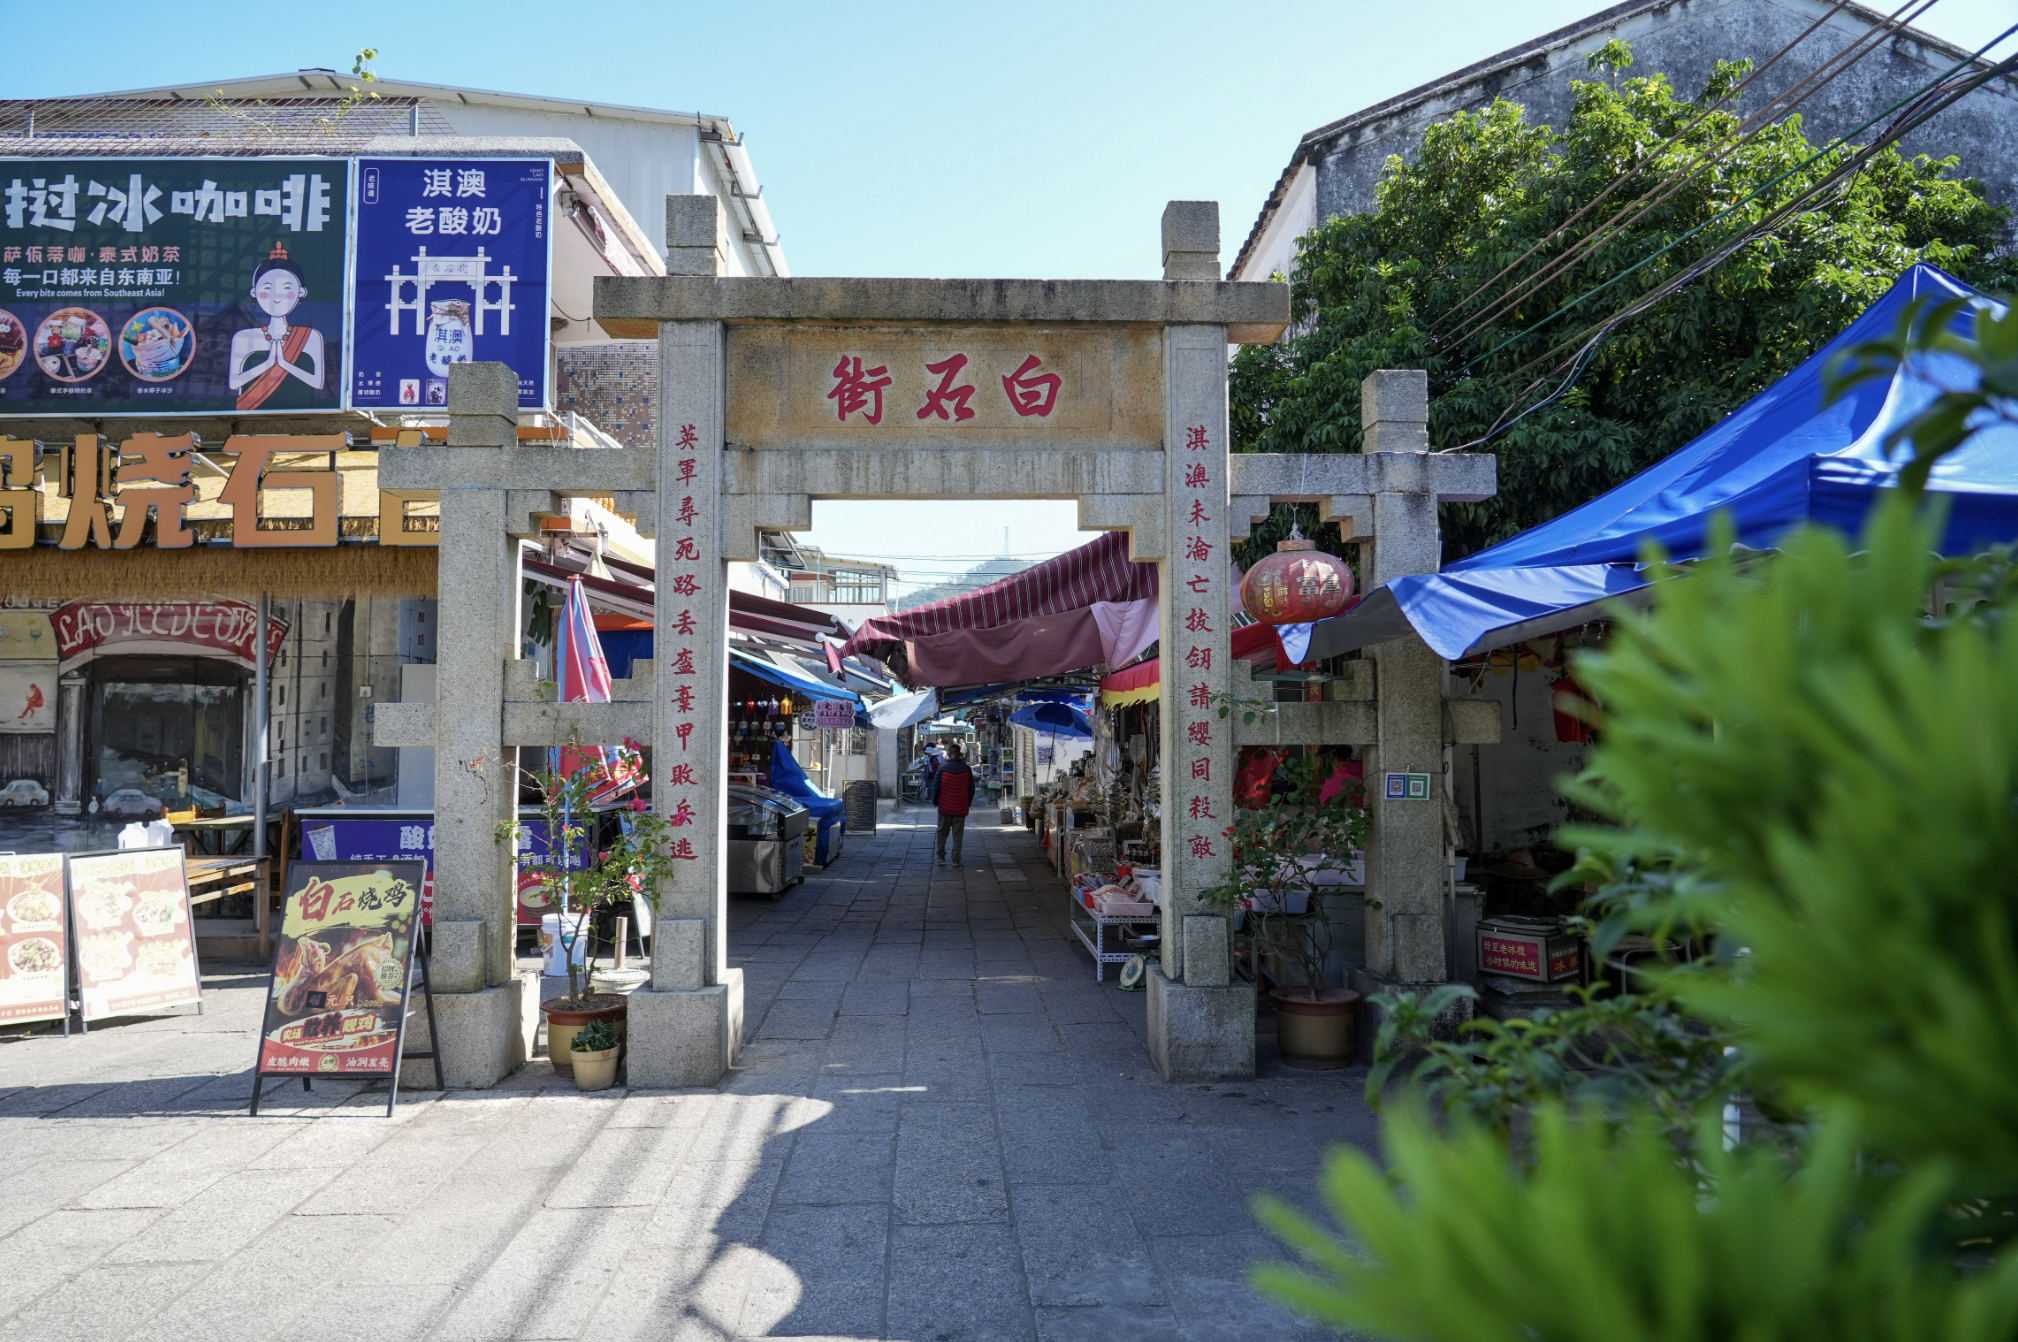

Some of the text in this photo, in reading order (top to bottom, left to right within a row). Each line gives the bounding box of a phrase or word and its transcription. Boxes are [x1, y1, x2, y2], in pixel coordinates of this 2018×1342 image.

[423, 168, 486, 198] 淇澳
[405, 206, 501, 235] 老酸奶
[16, 288, 39, 298] Every
[40, 288, 56, 297] bite
[83, 288, 102, 297] from
[104, 288, 144, 297] Southeast
[145, 288, 165, 297] Asia!
[433, 328, 463, 344] 淇澳
[299, 879, 407, 922] 白石烧鸡
